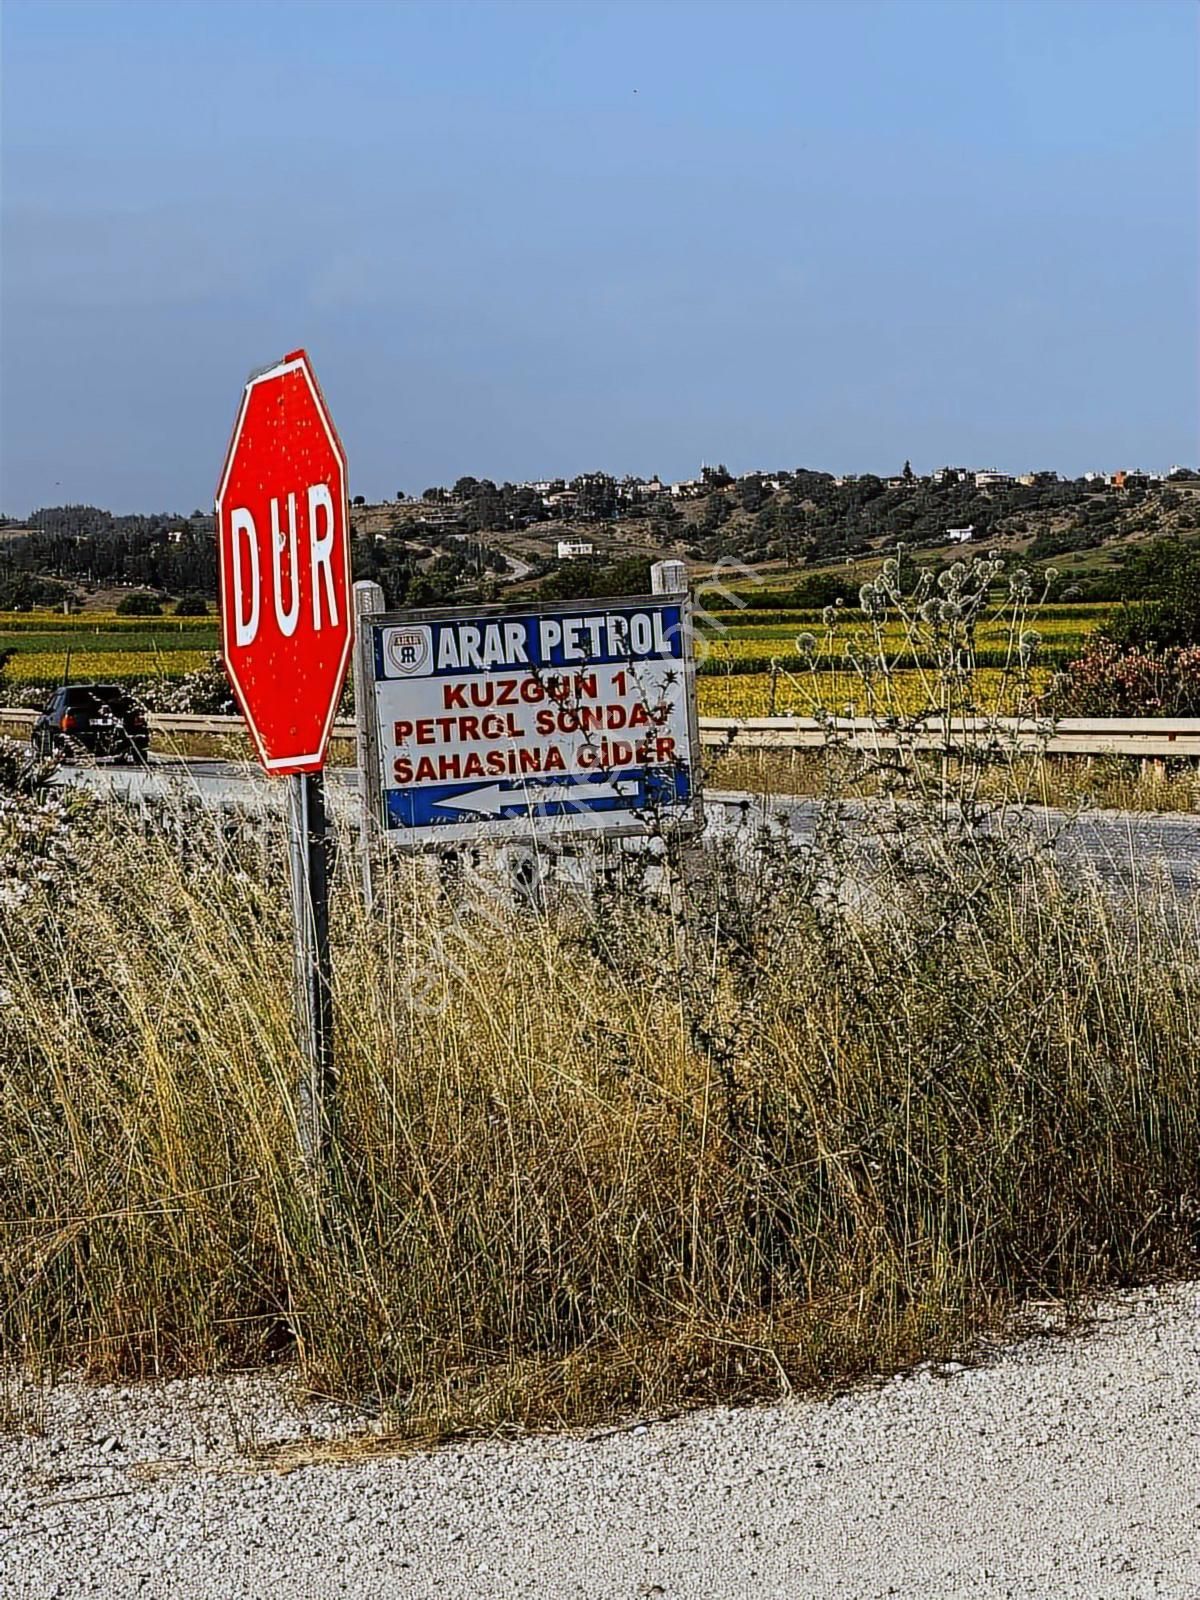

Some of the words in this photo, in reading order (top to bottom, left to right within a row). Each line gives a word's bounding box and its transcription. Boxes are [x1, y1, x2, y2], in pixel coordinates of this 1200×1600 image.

[231, 483, 339, 647] DUR
[437, 622, 529, 669] ARAR
[540, 613, 672, 661] PETROL
[443, 674, 598, 709] KUZGUN
[611, 671, 626, 697] 1
[394, 713, 525, 746] PETROL
[576, 736, 676, 768] GİDER
